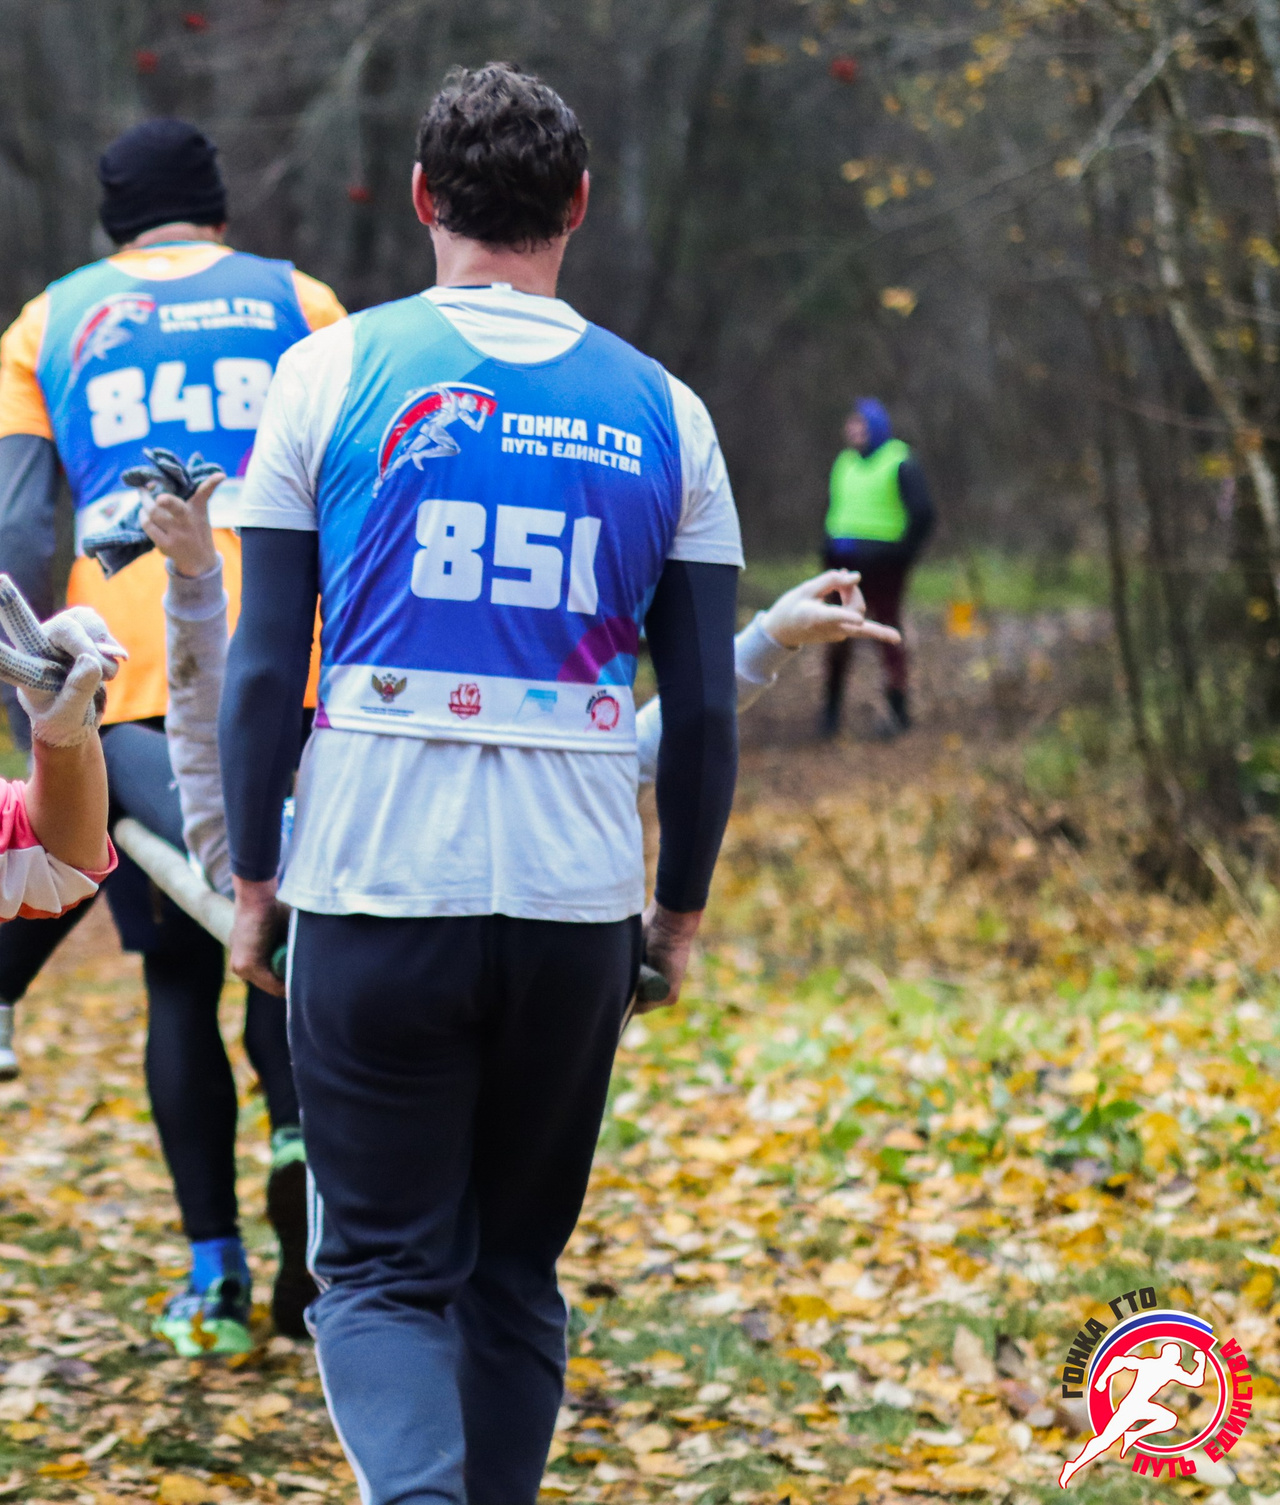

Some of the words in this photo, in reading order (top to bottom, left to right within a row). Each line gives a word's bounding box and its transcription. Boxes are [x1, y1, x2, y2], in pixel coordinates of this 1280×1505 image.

[86, 357, 274, 448] 848
[501, 412, 588, 441] ГОНКА
[597, 423, 642, 458] ГТО
[501, 436, 548, 457] ПУТЬ
[552, 441, 641, 476] ЕДИНСТВА
[410, 498, 602, 616] 851
